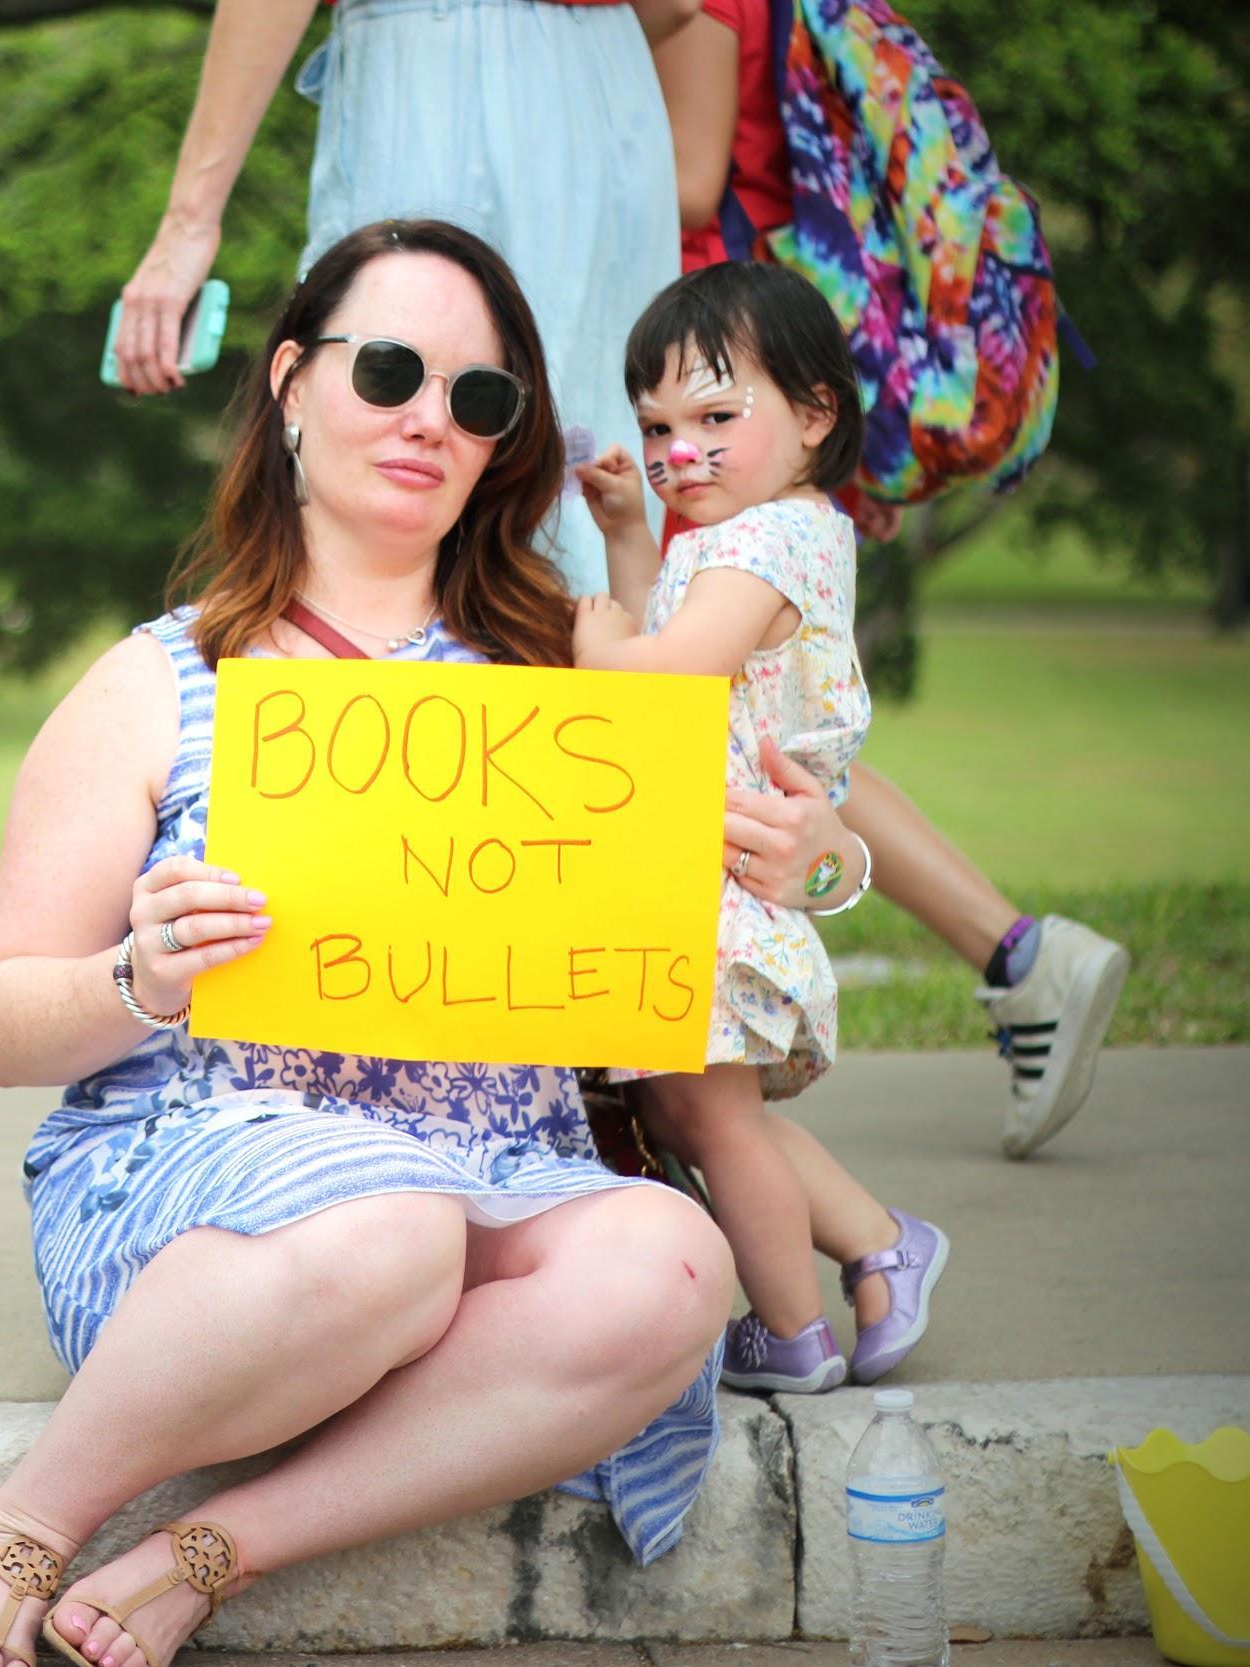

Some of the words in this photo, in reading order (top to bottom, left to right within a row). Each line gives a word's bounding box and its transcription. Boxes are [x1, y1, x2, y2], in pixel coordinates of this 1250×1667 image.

[251, 689, 636, 822] BOOKS
[401, 833, 593, 898] NOT
[310, 932, 695, 1023] BULLETS
[897, 1509, 942, 1523] DRINK
